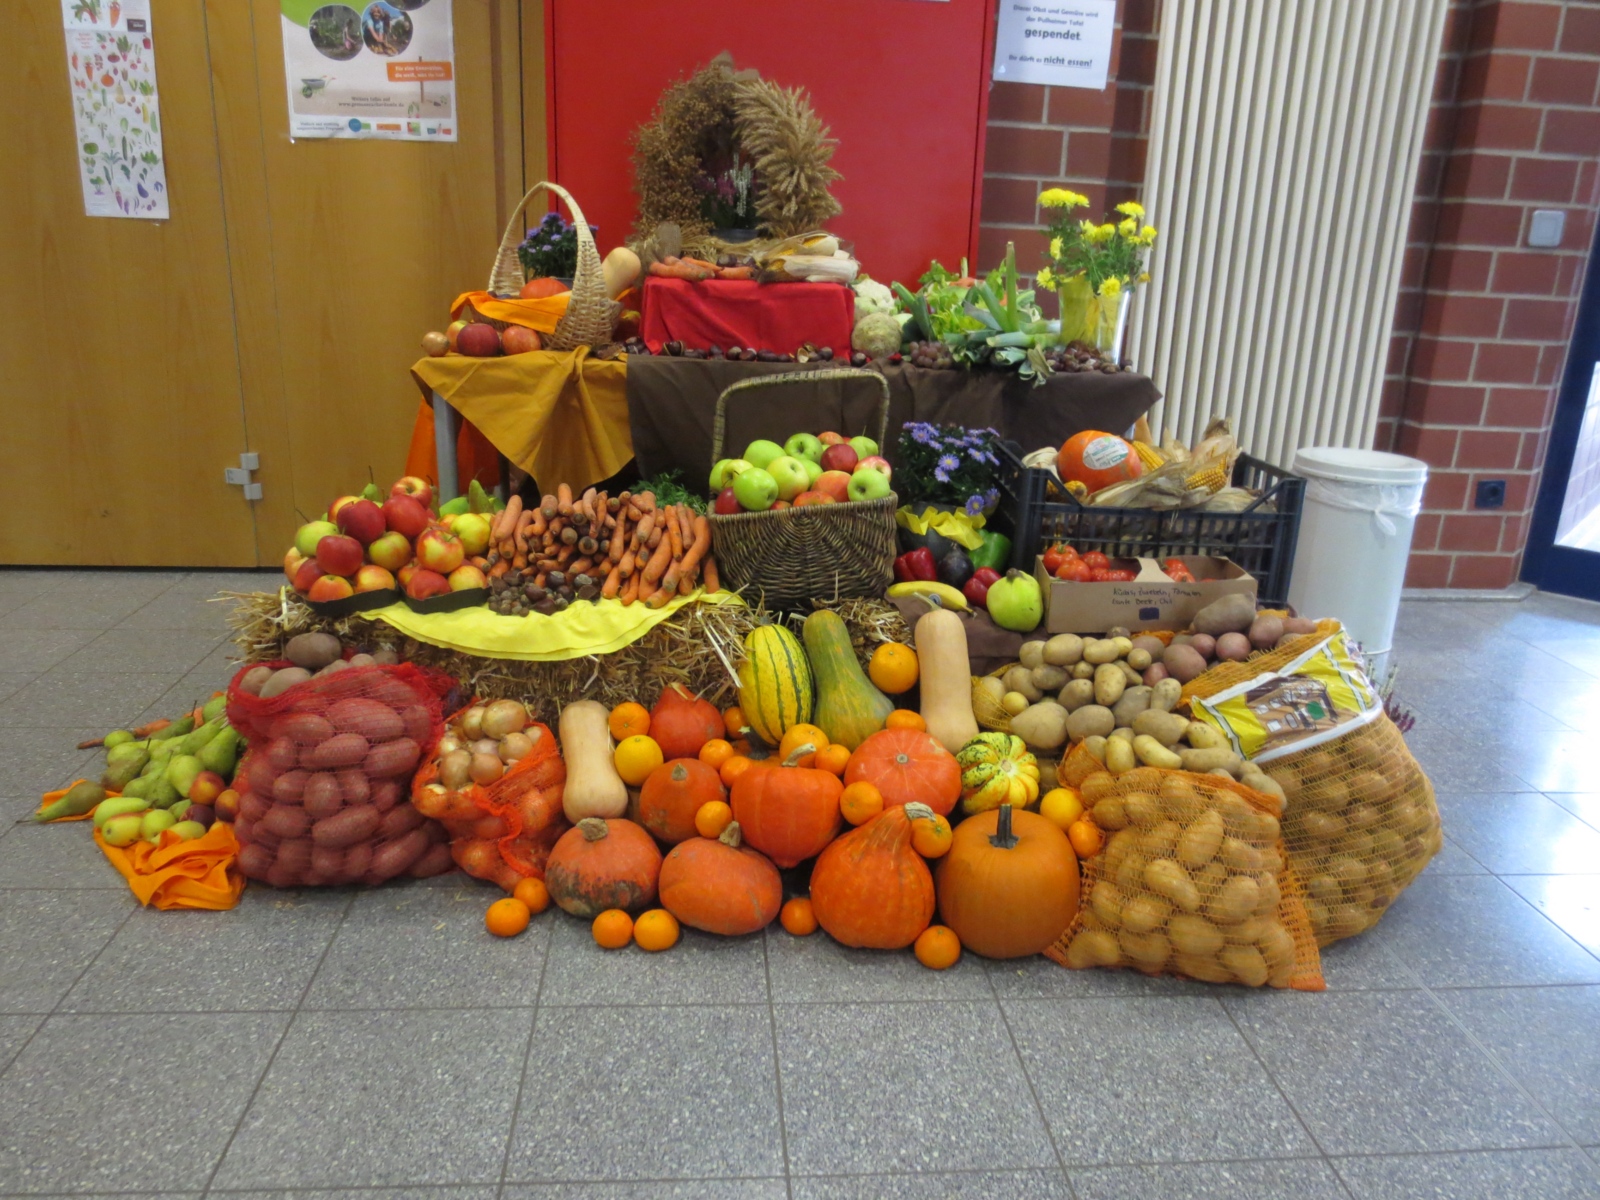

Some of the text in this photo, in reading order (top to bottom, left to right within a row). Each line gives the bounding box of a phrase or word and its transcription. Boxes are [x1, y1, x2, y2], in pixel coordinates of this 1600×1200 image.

[1061, 8, 1084, 17] Gemüse
[1037, 16, 1067, 25] Pulheimer
[1069, 19, 1084, 27] Tafel
[1024, 28, 1082, 41] gespendet.
[1044, 55, 1065, 65] nicht
[1067, 59, 1093, 67] essen!
